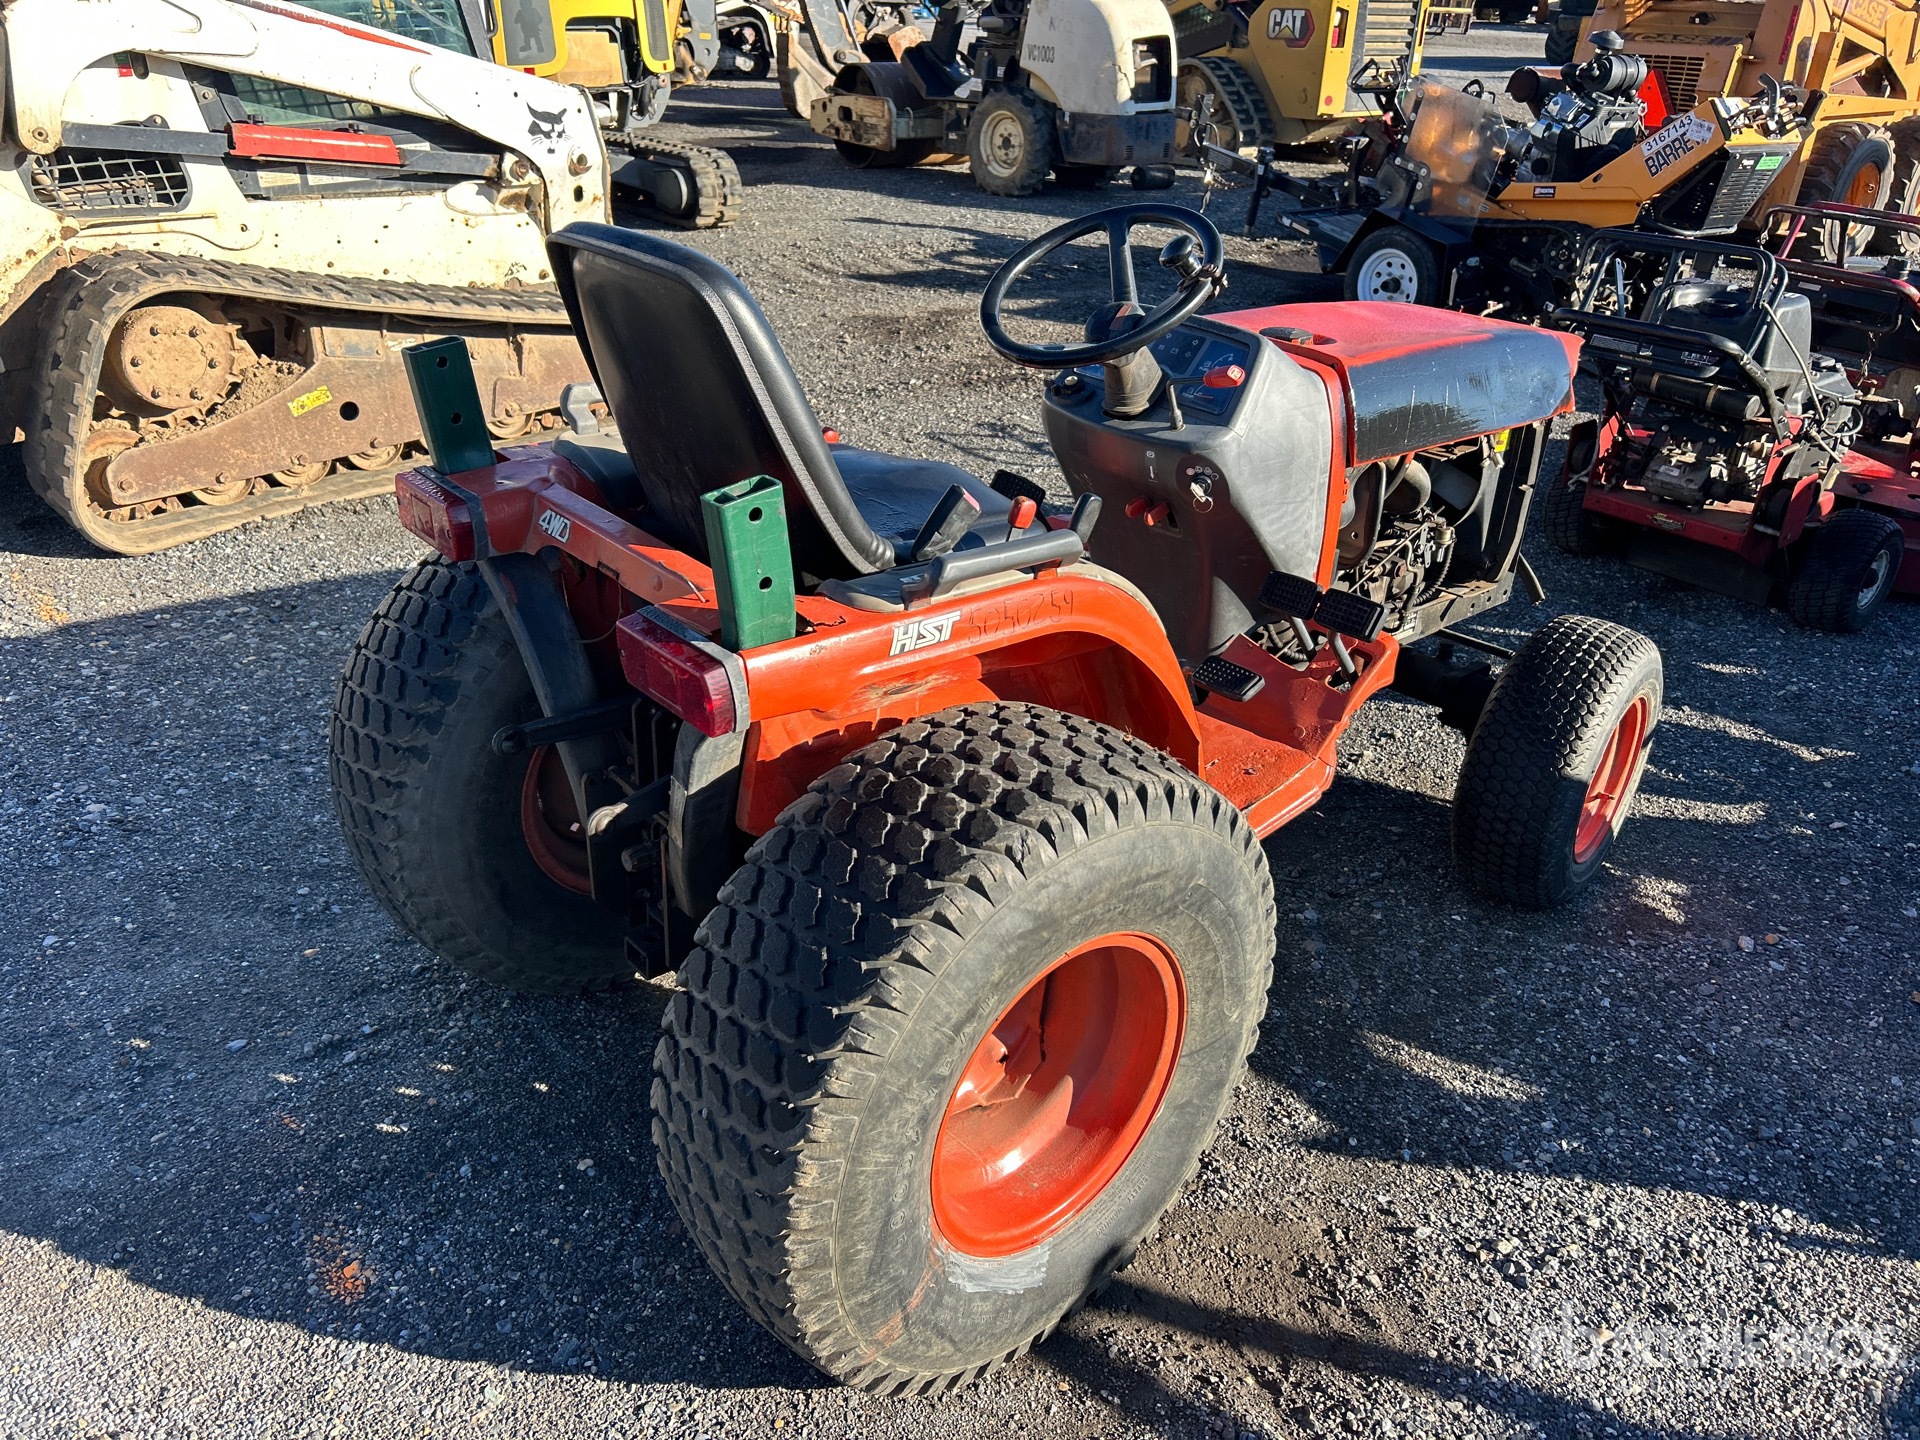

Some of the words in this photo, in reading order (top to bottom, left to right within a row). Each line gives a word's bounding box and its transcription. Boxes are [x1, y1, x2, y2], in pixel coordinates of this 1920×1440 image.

[1268, 9, 1305, 39] CAT
[1027, 44, 1055, 63] VC1003
[1644, 115, 1693, 152] 3167143
[1644, 129, 1708, 178] BARRE
[538, 509, 571, 543] 4WD
[888, 610, 961, 657] HST
